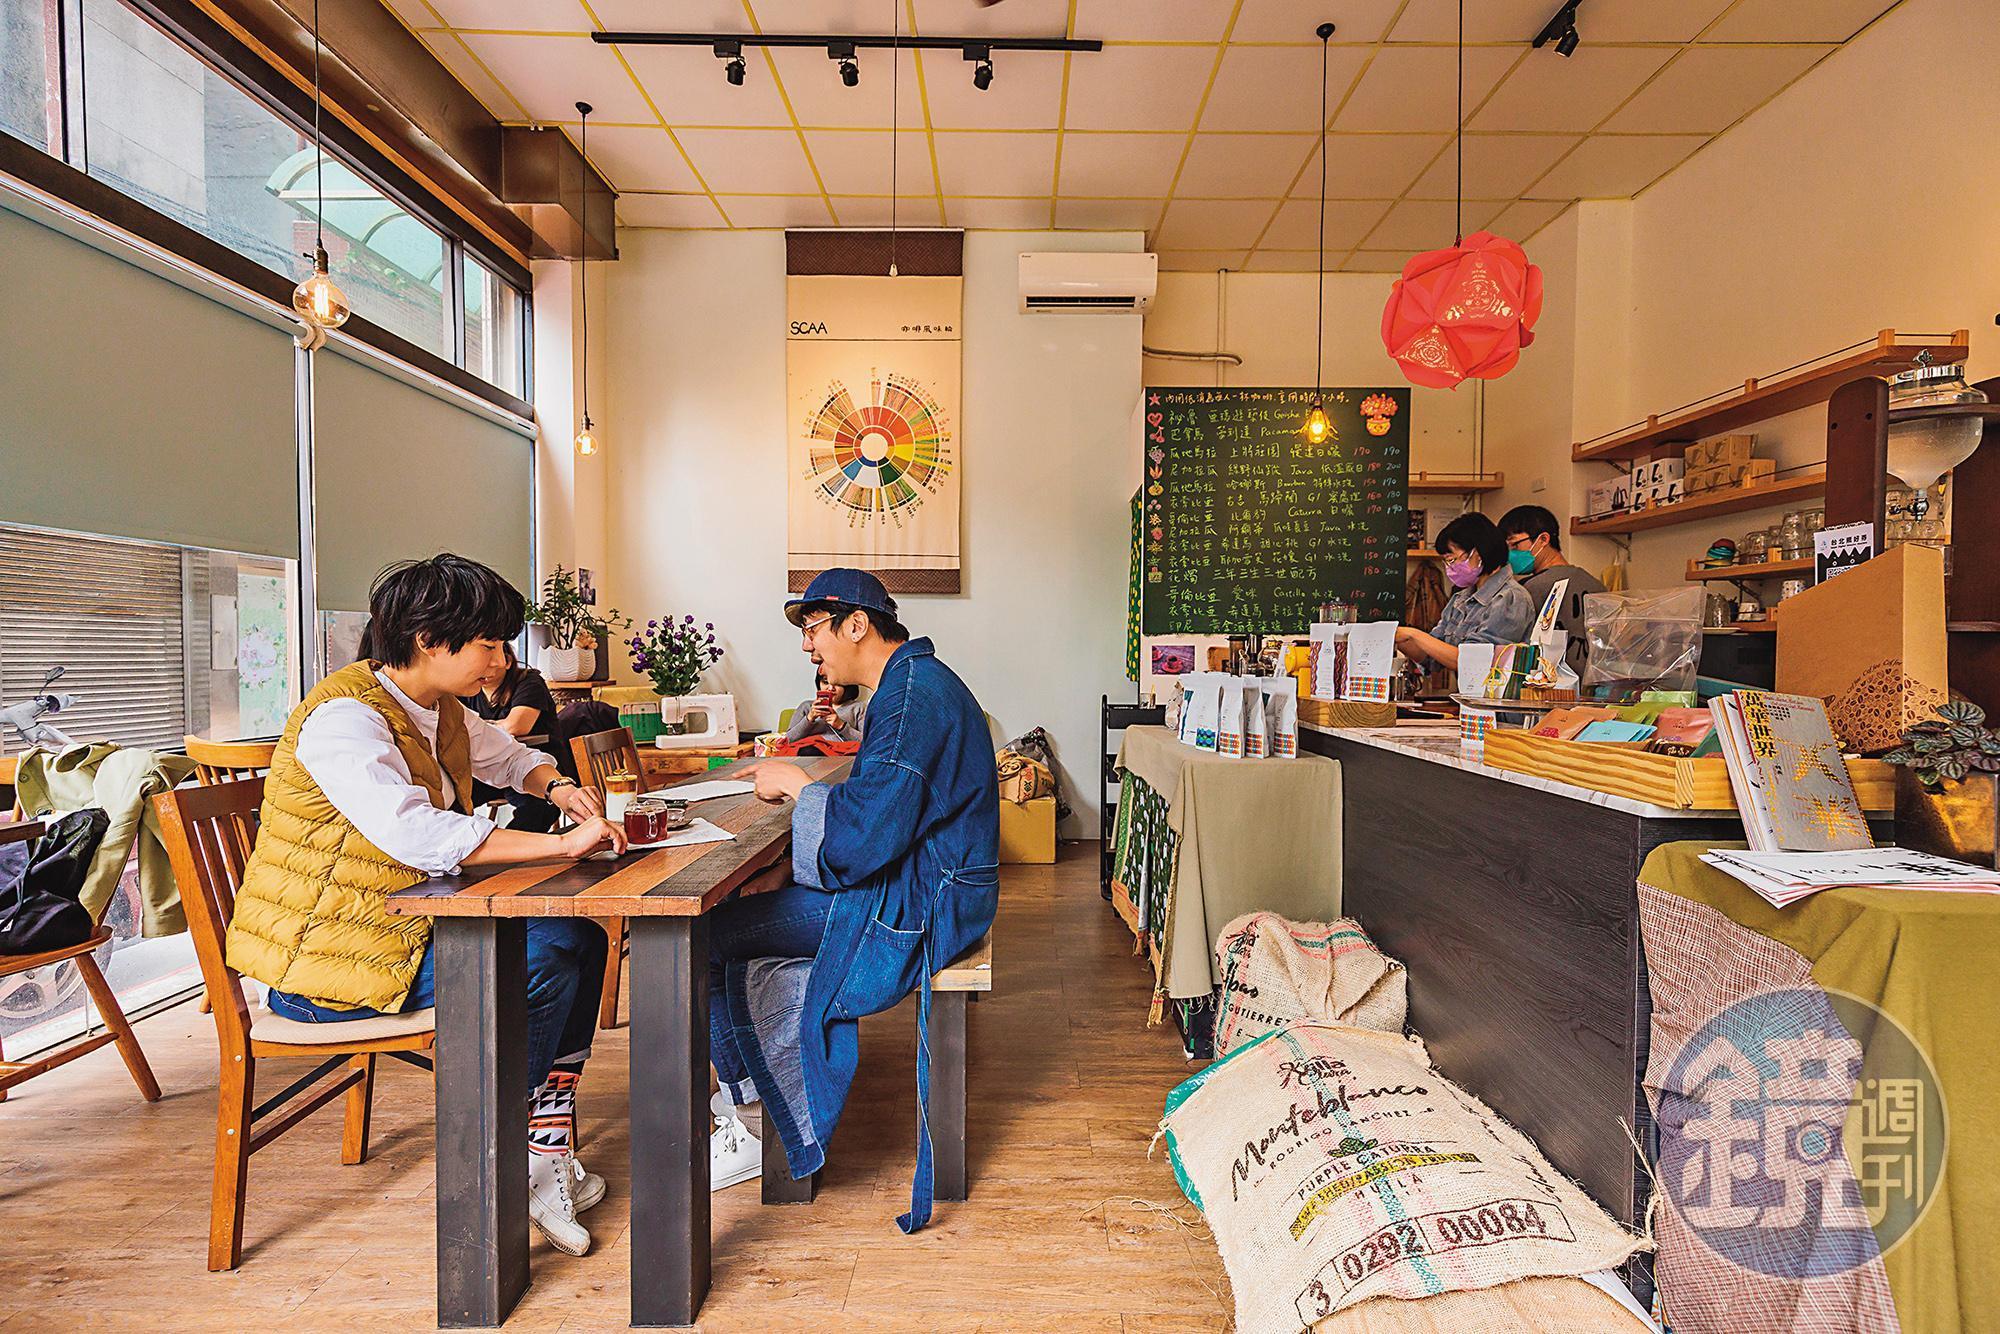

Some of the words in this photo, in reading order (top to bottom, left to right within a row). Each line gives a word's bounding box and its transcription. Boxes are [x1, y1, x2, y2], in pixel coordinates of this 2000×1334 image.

[791, 321, 828, 335] SCAA
[901, 325, 953, 334] 咖啡風味輪
[1169, 445, 1217, 459] 瓜地馬拉
[1354, 447, 1371, 456] 170
[1171, 463, 1218, 477] 尼加拉瓜
[1291, 464, 1313, 476] Java
[1169, 481, 1217, 494] 瓜地馬拉
[1169, 495, 1215, 509] 衣索比亞
[1227, 494, 1244, 507] 古吉
[1308, 492, 1321, 502] G1
[1367, 492, 1382, 501] 160
[1168, 510, 1216, 526] 哥倫比亞
[1288, 506, 1323, 517] Caturra
[1367, 505, 1382, 515] 170
[1168, 524, 1218, 538] 尼加拉瓜
[1320, 521, 1341, 532] Java
[1347, 521, 1369, 531] 水洗
[1168, 539, 1213, 552] 衣索比亞
[1308, 538, 1321, 548] G1
[1327, 537, 1351, 547] 水洗
[1363, 536, 1378, 544] 160
[1169, 555, 1212, 568] 衣索比亞
[1305, 552, 1317, 562] G1
[1324, 552, 1352, 562] 水洗
[1364, 552, 1379, 560] 150
[1384, 551, 1400, 560] 170
[1364, 567, 1380, 576] 180
[1165, 585, 1221, 603] 哥倫比亞
[1312, 588, 1336, 599] 水洗
[1350, 590, 1366, 599] 150
[1377, 591, 1396, 601] 170
[1169, 603, 1217, 618] 衣索比亞
[1169, 619, 1195, 633] 印尼
[1231, 1084, 1429, 1203] Monteblanco
[1269, 1126, 1333, 1171] RODRIGO
[1297, 1160, 1352, 1201] PURPLE
[1356, 1145, 1438, 1166] CATURRA
[1309, 1280, 1331, 1317] 3
[1342, 1225, 1425, 1281] 0292
[1436, 1202, 1547, 1245] 00084
